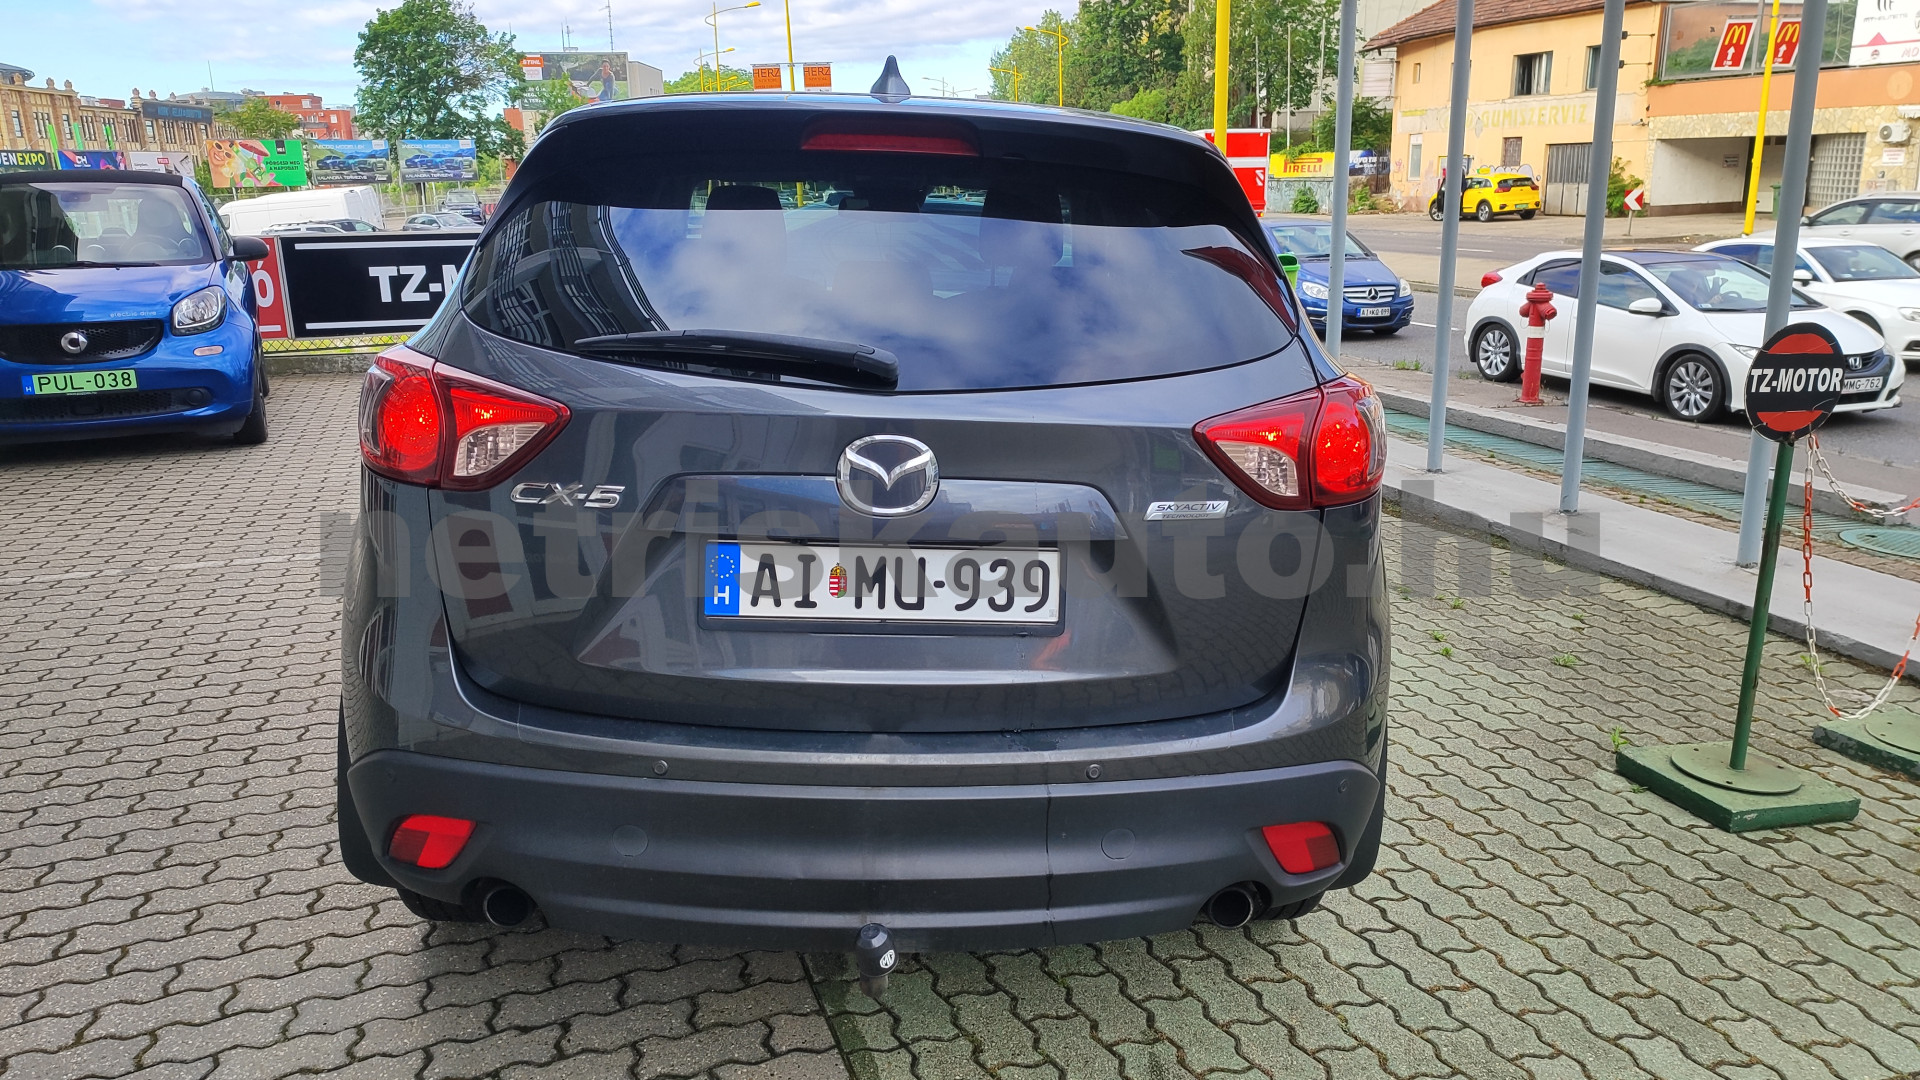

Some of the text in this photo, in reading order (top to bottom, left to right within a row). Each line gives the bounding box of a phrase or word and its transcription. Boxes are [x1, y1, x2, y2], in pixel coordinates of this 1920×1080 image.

[753, 68, 781, 77] HERZ
[803, 67, 831, 76] HERZ
[1481, 103, 1588, 128] GUMISZERVIZ
[0, 152, 46, 166] ENEXPO
[1283, 157, 1323, 173] PIRELLI
[37, 371, 132, 393] PUL-038
[1750, 367, 1844, 393] TZ-MOTOR
[1843, 378, 1881, 390] MMG-762
[510, 481, 626, 508] CX-5
[1156, 503, 1222, 511] SKYACTIV
[853, 555, 1051, 613] MU-939
